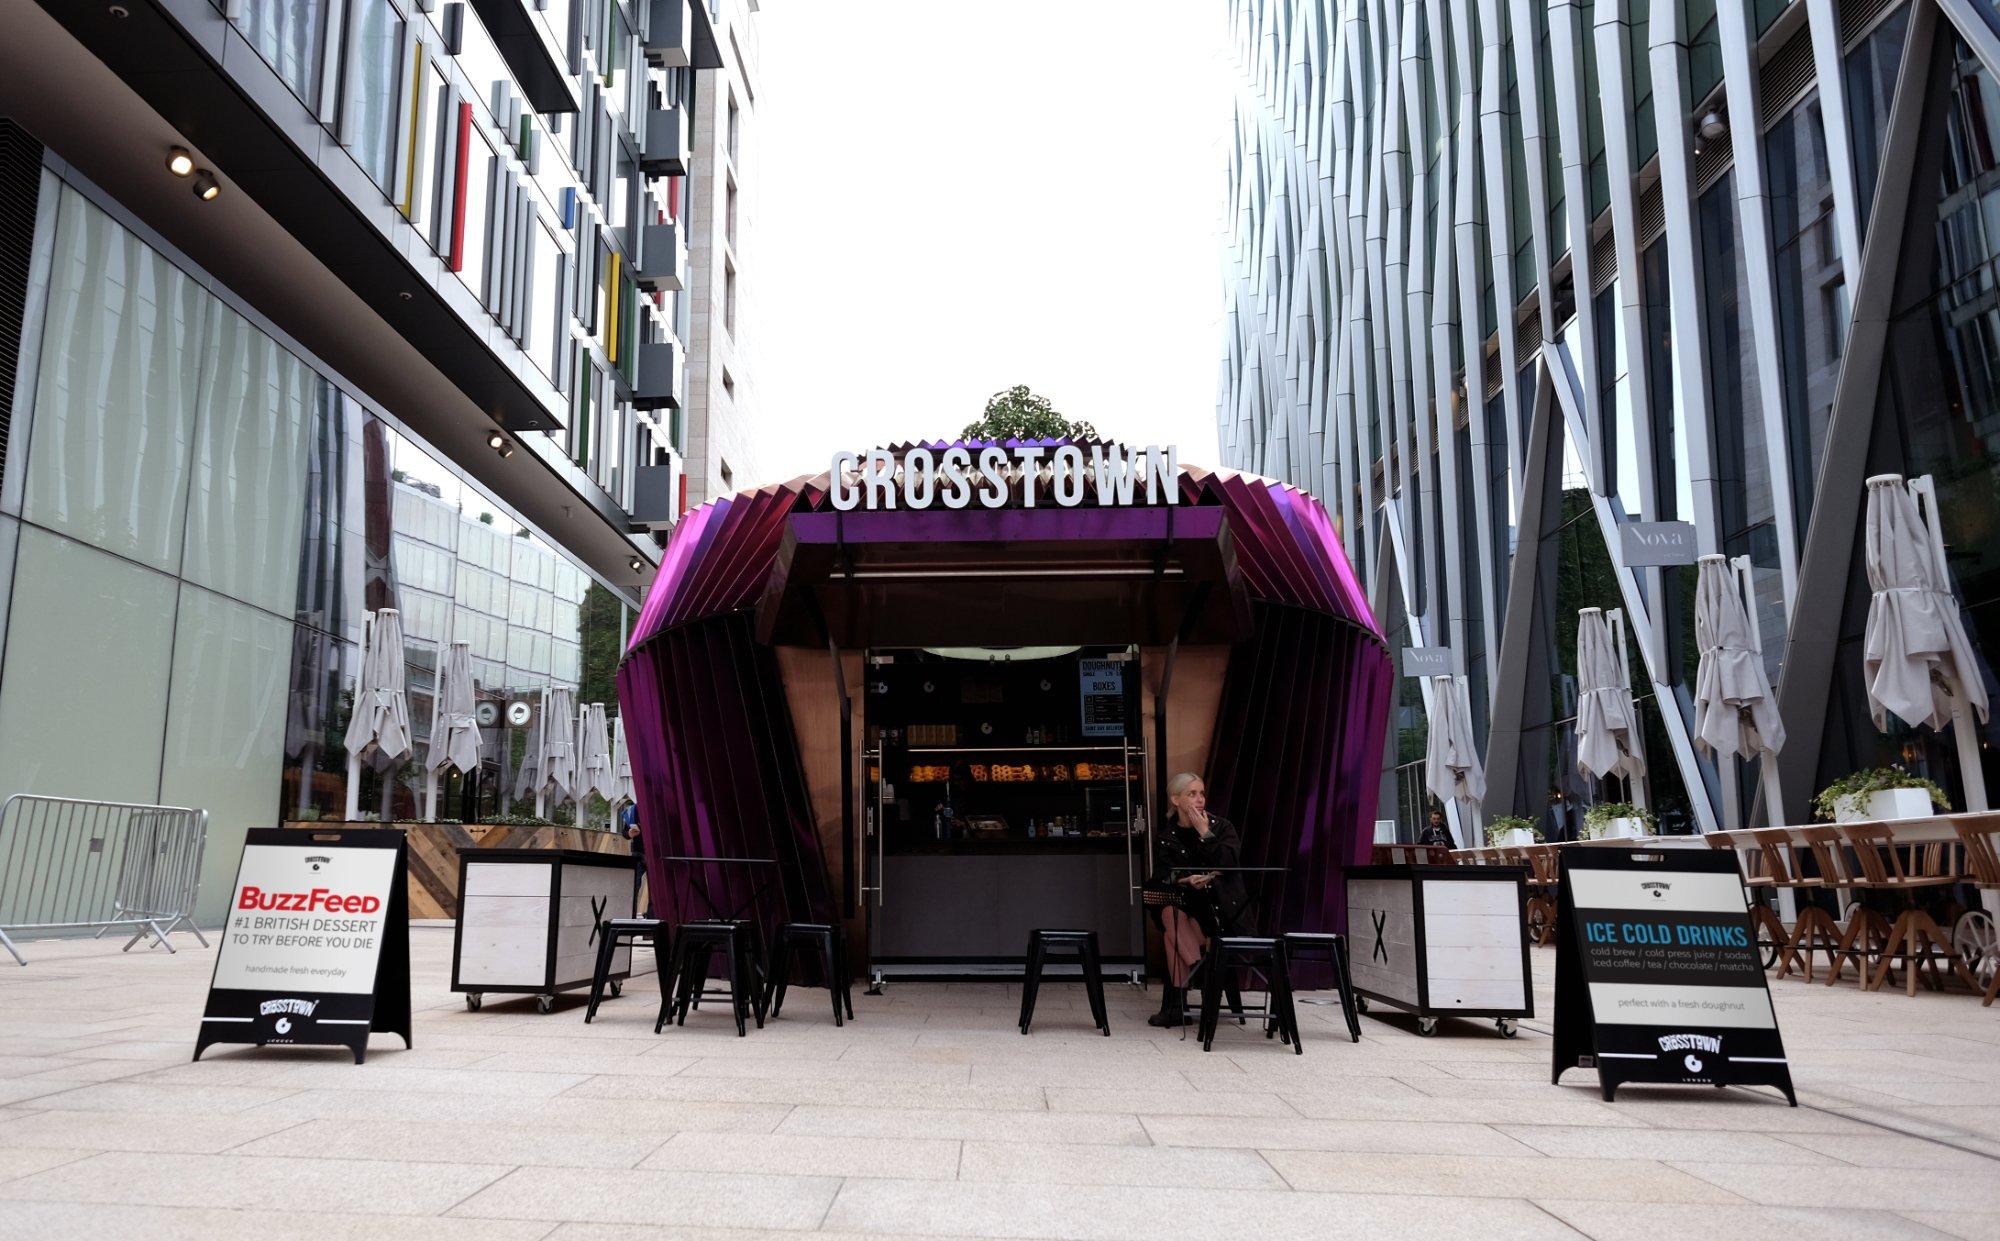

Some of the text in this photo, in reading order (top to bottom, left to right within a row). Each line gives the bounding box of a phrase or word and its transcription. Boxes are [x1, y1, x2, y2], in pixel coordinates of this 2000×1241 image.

[830, 445, 1180, 511] CROSSTOWN
[1630, 527, 1683, 546] Nova
[1092, 681, 1116, 691] BOXES
[234, 917, 377, 933] #1 BRITISH DESSERT
[232, 933, 375, 949] TO TRY BEFORE YOU DIE
[1586, 922, 1748, 947] ICE COLD DRINKS
[1590, 947, 1610, 955] cold
[1612, 947, 1635, 956] brew
[1645, 948, 1664, 957] cold
[1667, 950, 1691, 959] press
[1694, 950, 1715, 960] juice
[1724, 950, 1753, 960] sodas
[245, 965, 347, 978] handmade fresh everyday
[1592, 958, 1612, 967] iced
[1613, 958, 1641, 968] coffee
[1647, 960, 1662, 968] tea
[1668, 960, 1713, 970] chocolate
[1719, 962, 1754, 972] matcha
[260, 999, 317, 1017] CROSSTOWN
[1617, 998, 1648, 1008] perfect
[1649, 999, 1669, 1008] with
[1678, 999, 1699, 1009] fresh
[1701, 1000, 1745, 1011] doughnut
[1658, 1034, 1721, 1054] CROSSTOWN
